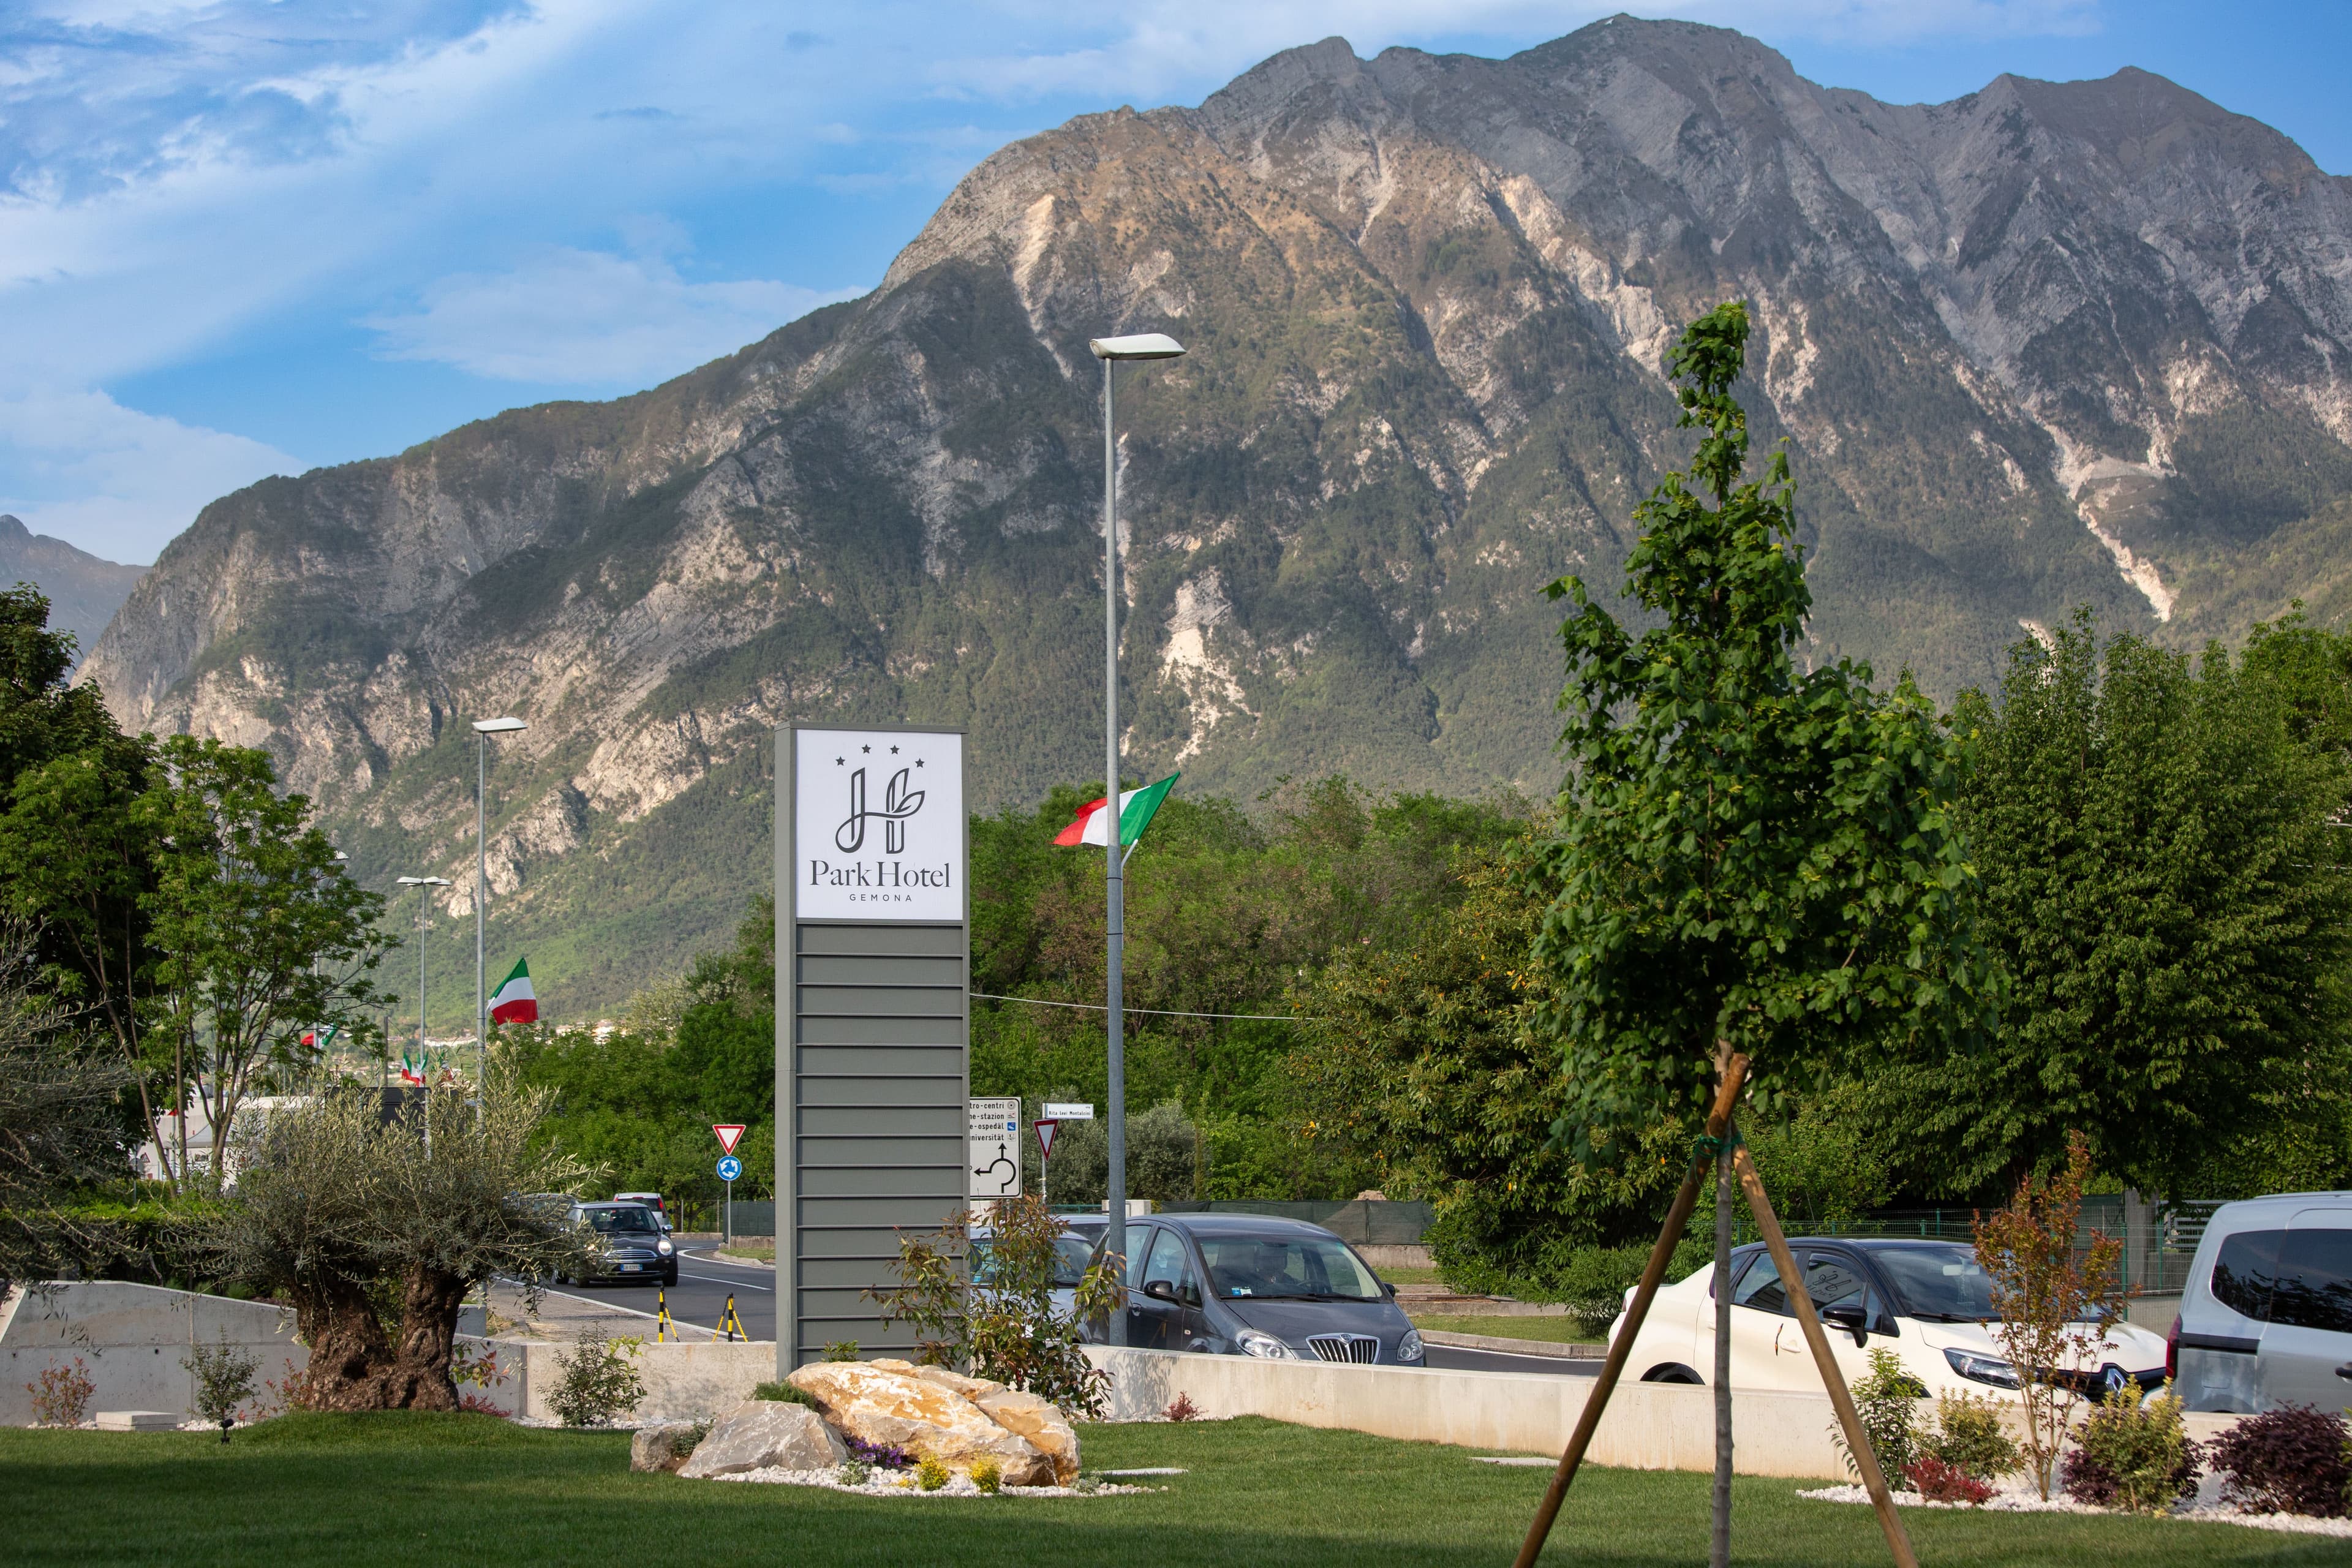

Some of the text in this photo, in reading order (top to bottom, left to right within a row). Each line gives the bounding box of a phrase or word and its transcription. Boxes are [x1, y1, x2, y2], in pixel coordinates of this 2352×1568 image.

[809, 860, 951, 888] Park Hotel
[849, 894, 912, 902] GEMONA
